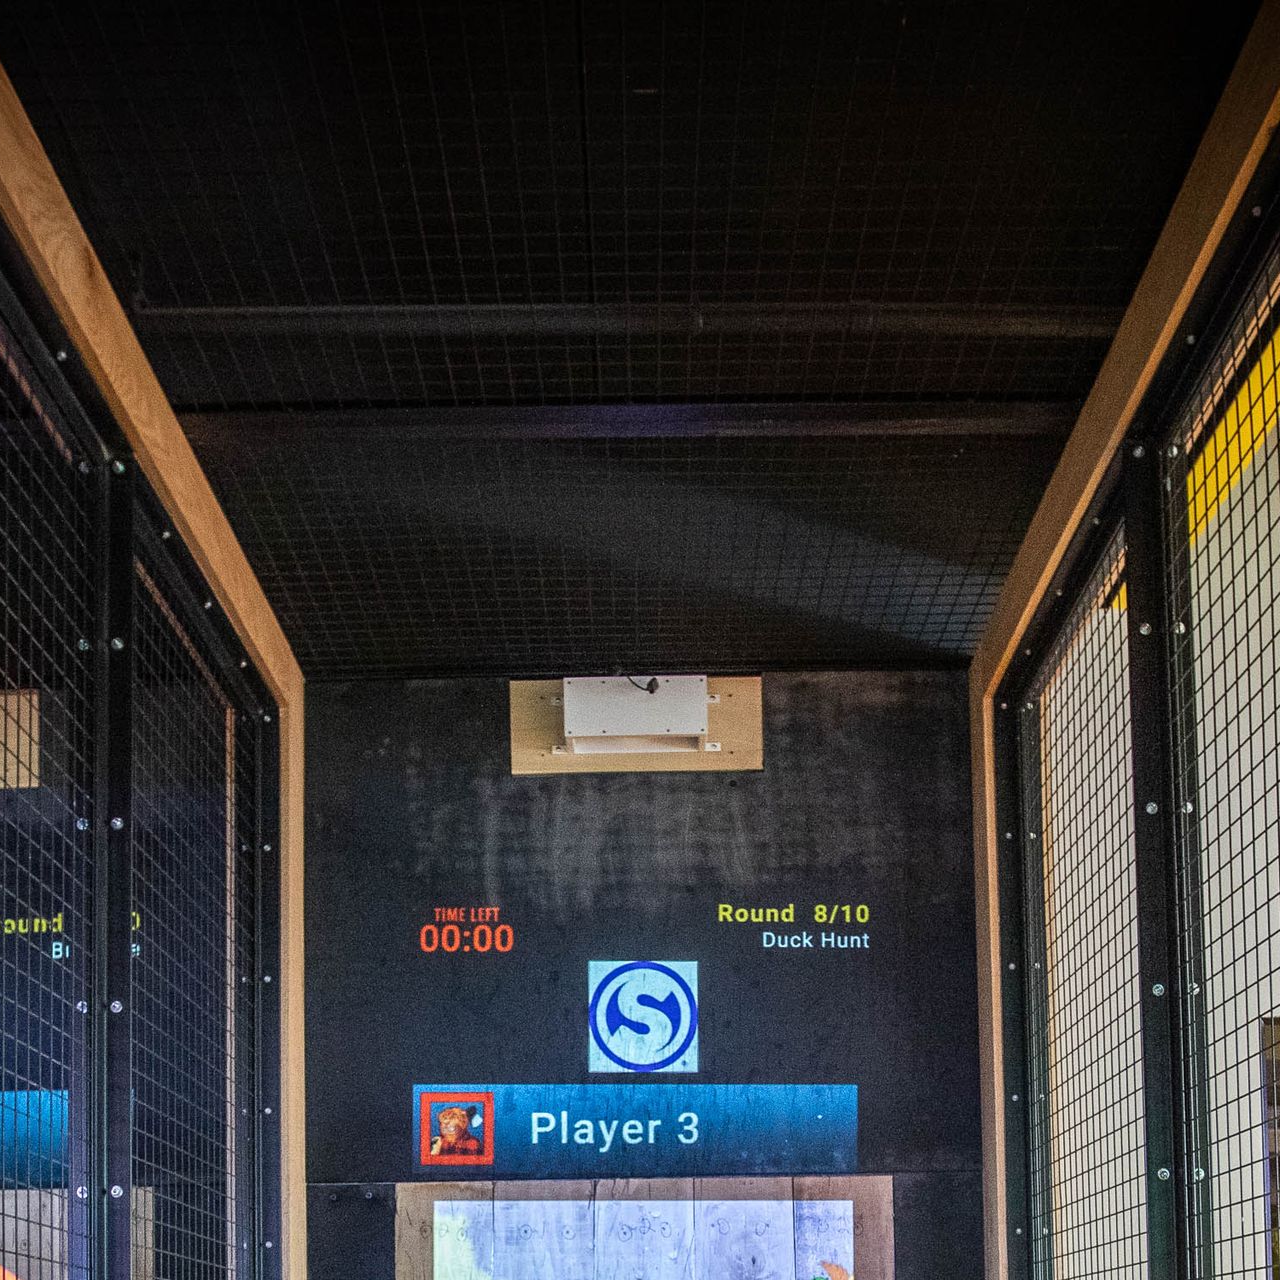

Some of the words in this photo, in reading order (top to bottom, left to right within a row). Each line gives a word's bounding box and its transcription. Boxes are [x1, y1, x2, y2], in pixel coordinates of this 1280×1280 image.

[433, 907, 466, 922] TIME
[470, 906, 501, 922] LEFT
[717, 903, 795, 924] Round
[813, 903, 870, 925] 8/10
[419, 924, 515, 953] 00:00
[762, 931, 814, 949] Duck
[820, 931, 870, 949] Hunt
[531, 1111, 662, 1153] Player
[677, 1111, 700, 1144] 3
